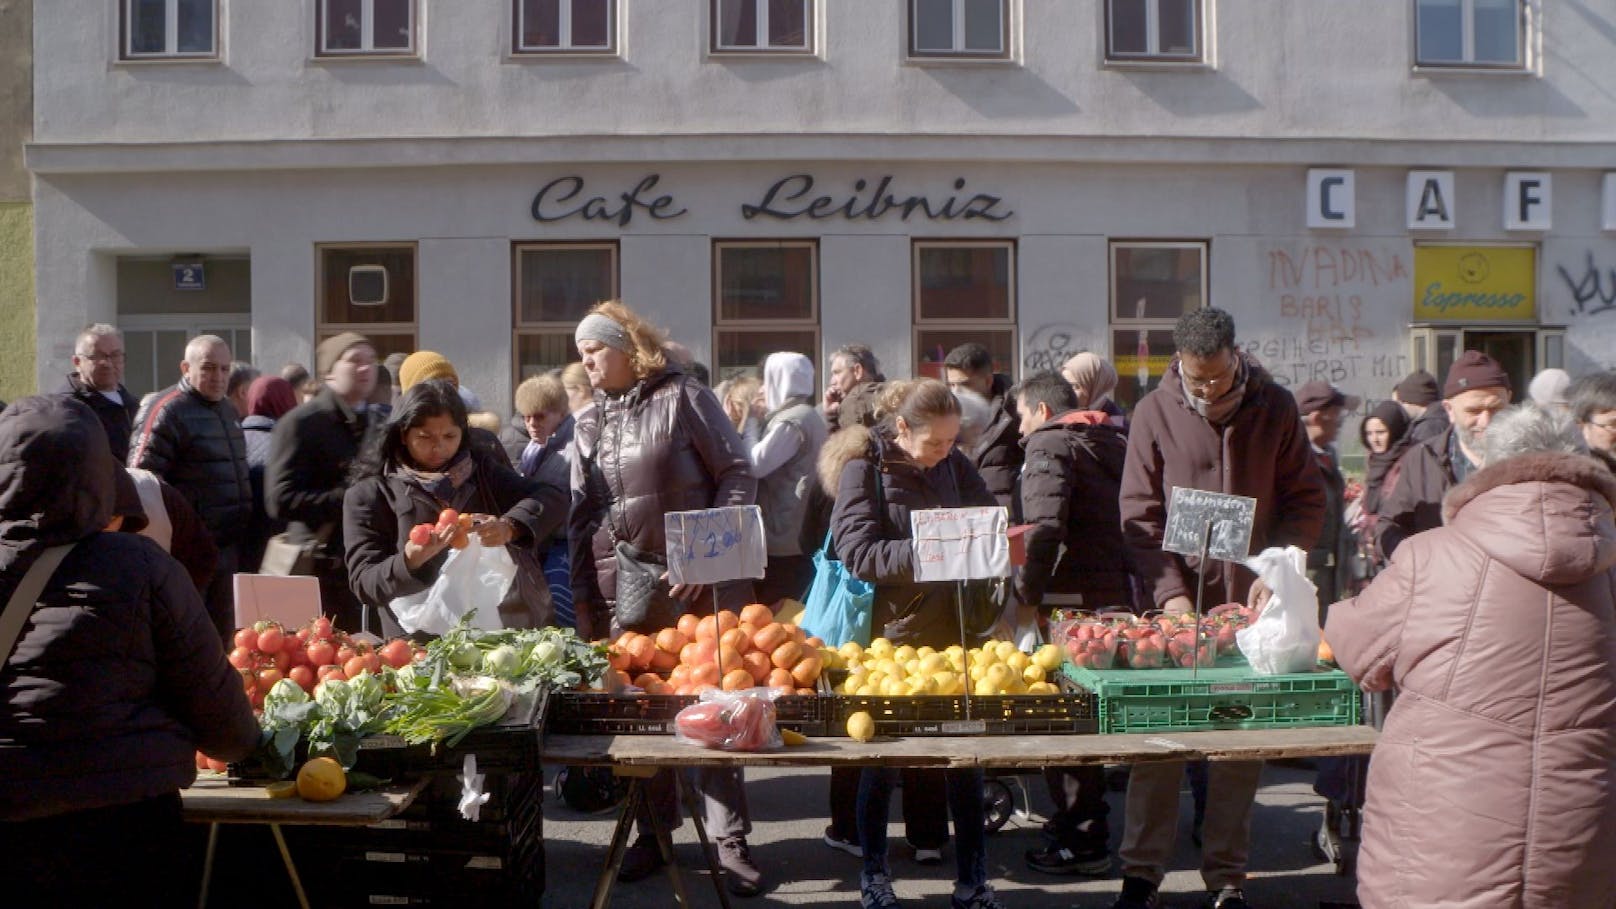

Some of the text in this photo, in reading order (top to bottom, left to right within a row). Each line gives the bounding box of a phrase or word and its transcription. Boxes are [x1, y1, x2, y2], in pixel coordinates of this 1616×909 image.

[531, 174, 1014, 226] Cafe Leibniz
[183, 268, 195, 282] 2
[1422, 282, 1526, 313] Espresso
[1236, 333, 1354, 361] REIHEIT
